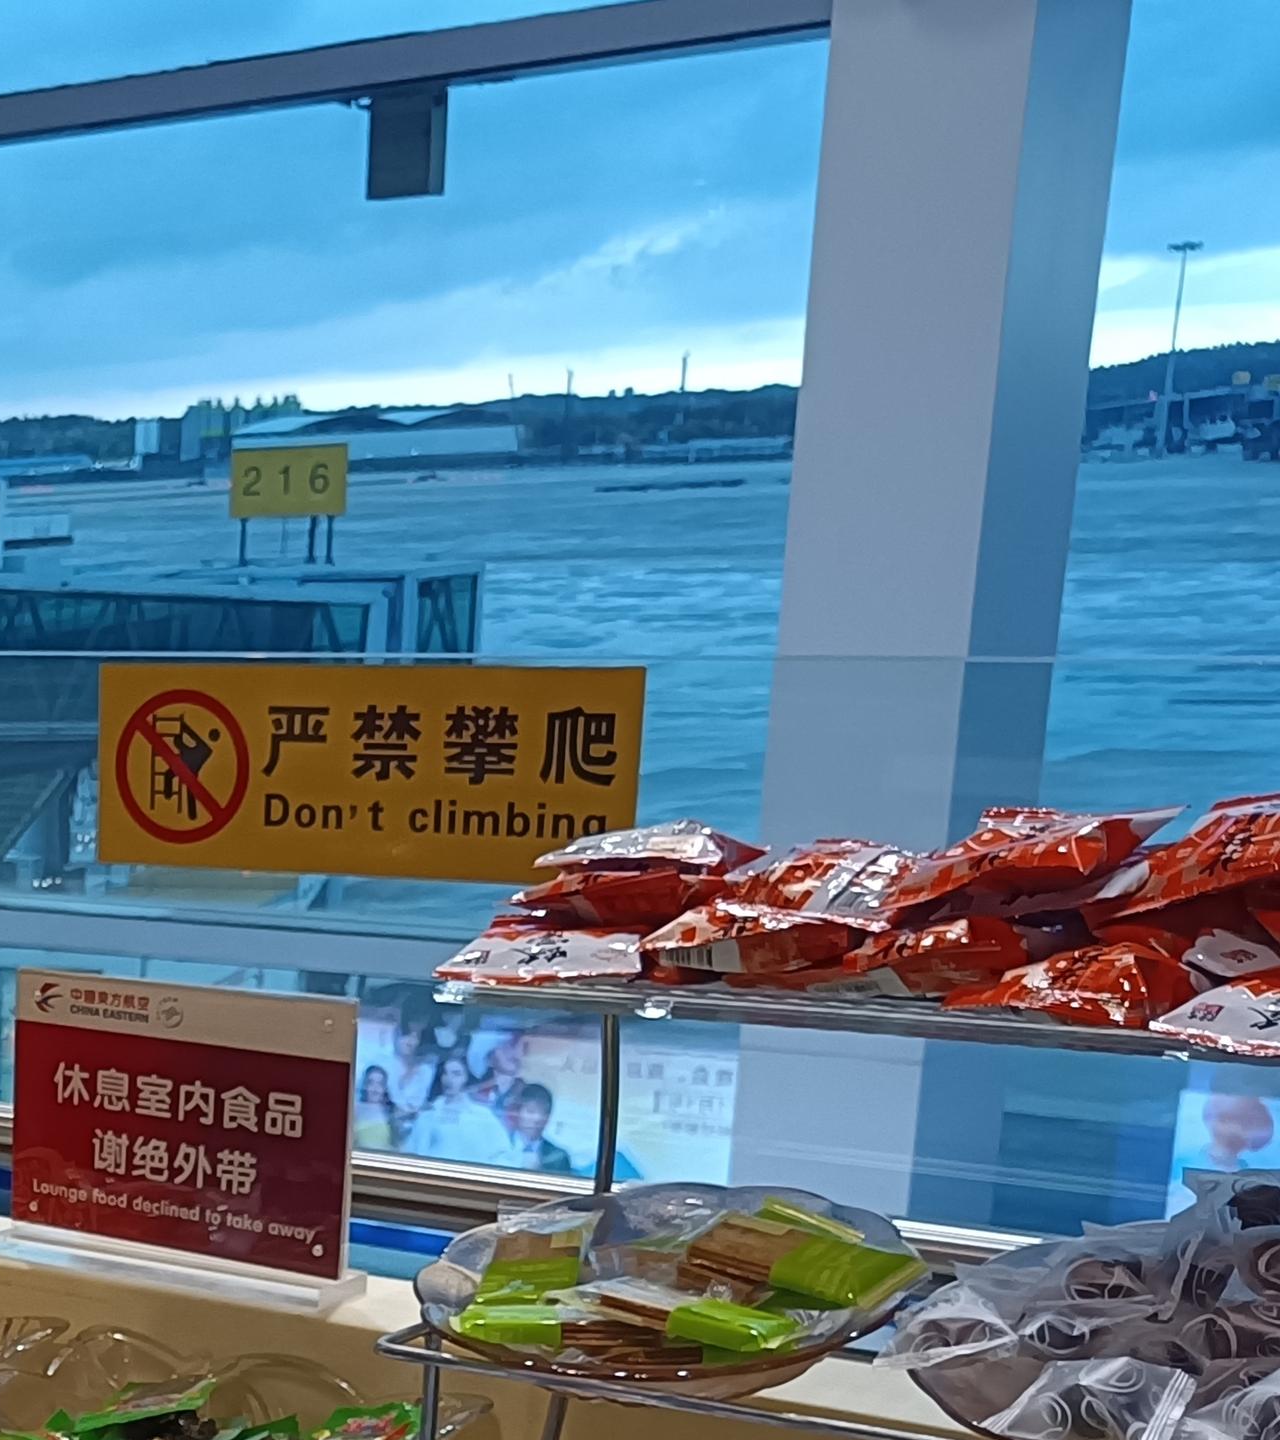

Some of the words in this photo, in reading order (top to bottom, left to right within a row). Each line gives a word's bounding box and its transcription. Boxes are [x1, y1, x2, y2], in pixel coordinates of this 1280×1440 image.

[241, 461, 332, 497] 216
[260, 703, 618, 787] 严禁攀爬
[408, 799, 608, 839] climbing
[70, 1004, 100, 1017] CHINA
[102, 1008, 149, 1023] EASTERN
[53, 1060, 304, 1139] 休息室内食品
[92, 1128, 258, 1197] 谢绝外带
[32, 1178, 88, 1204] Lounge
[91, 1187, 127, 1209] food
[132, 1194, 200, 1222] declined
[205, 1206, 222, 1227] to
[226, 1211, 264, 1233] take
[268, 1222, 317, 1244] away
